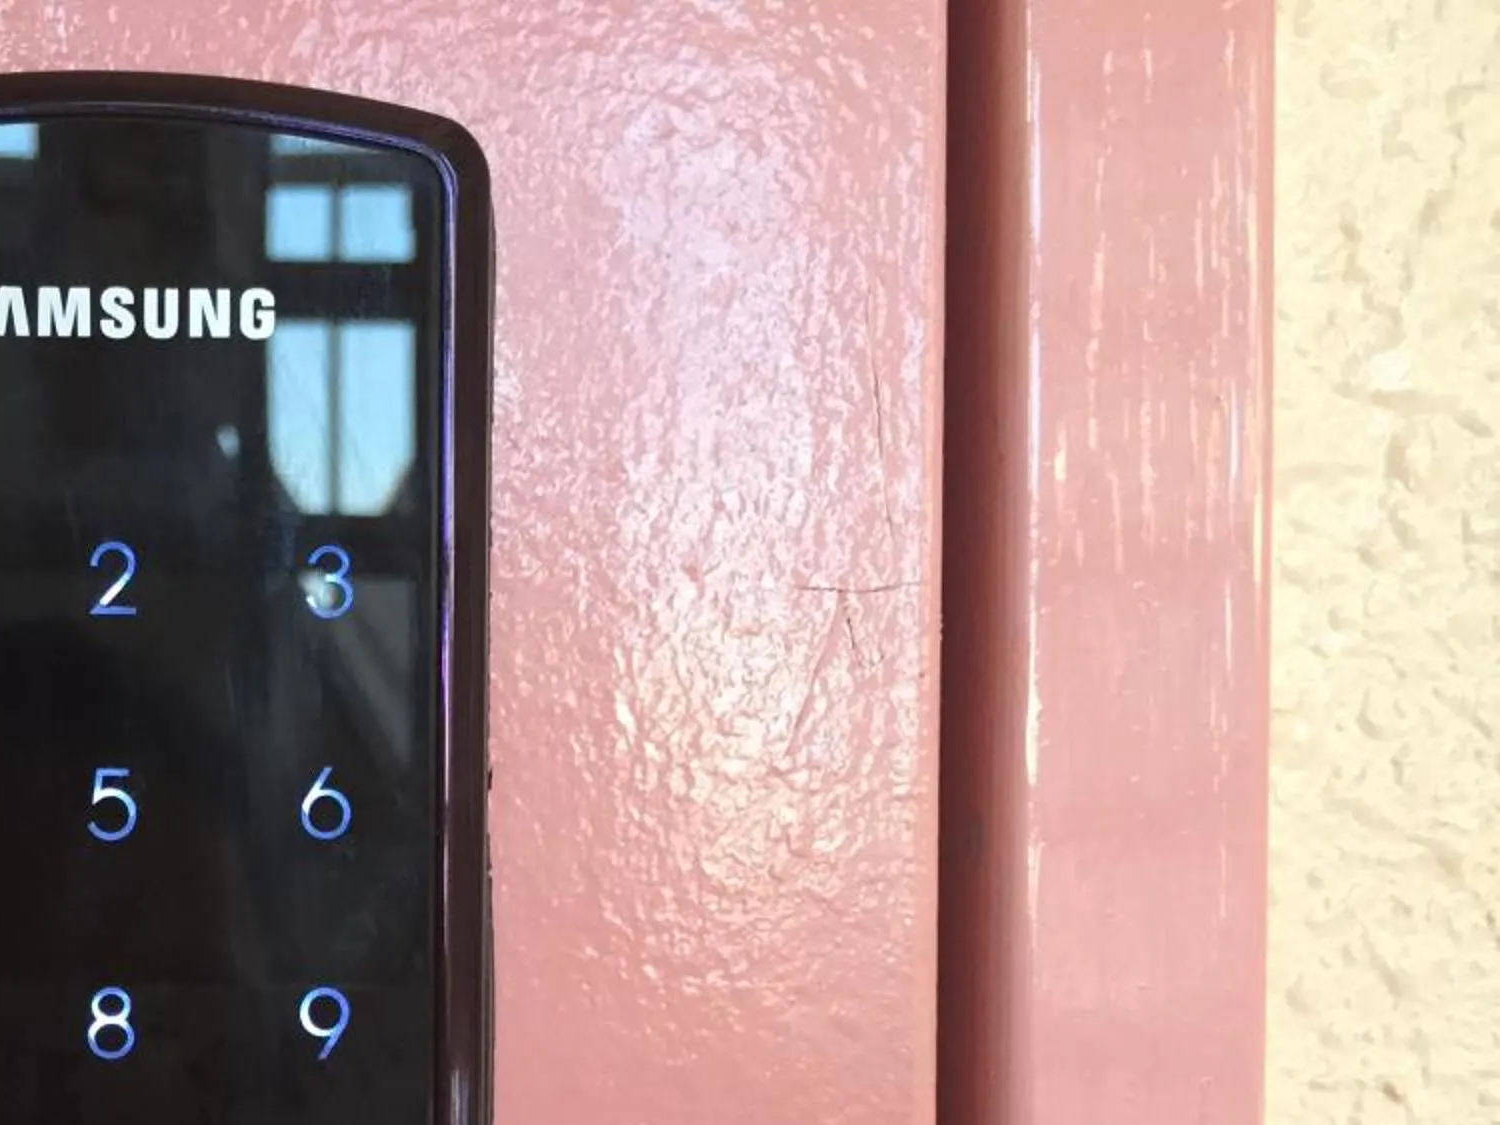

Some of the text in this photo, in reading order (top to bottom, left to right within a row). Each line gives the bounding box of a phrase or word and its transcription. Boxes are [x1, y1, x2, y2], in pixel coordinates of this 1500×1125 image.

[89, 541, 138, 616] 2
[306, 544, 354, 620] 3
[88, 767, 138, 842] 5
[300, 767, 352, 841] 6
[87, 986, 136, 1060] 8
[299, 986, 351, 1060] 9
